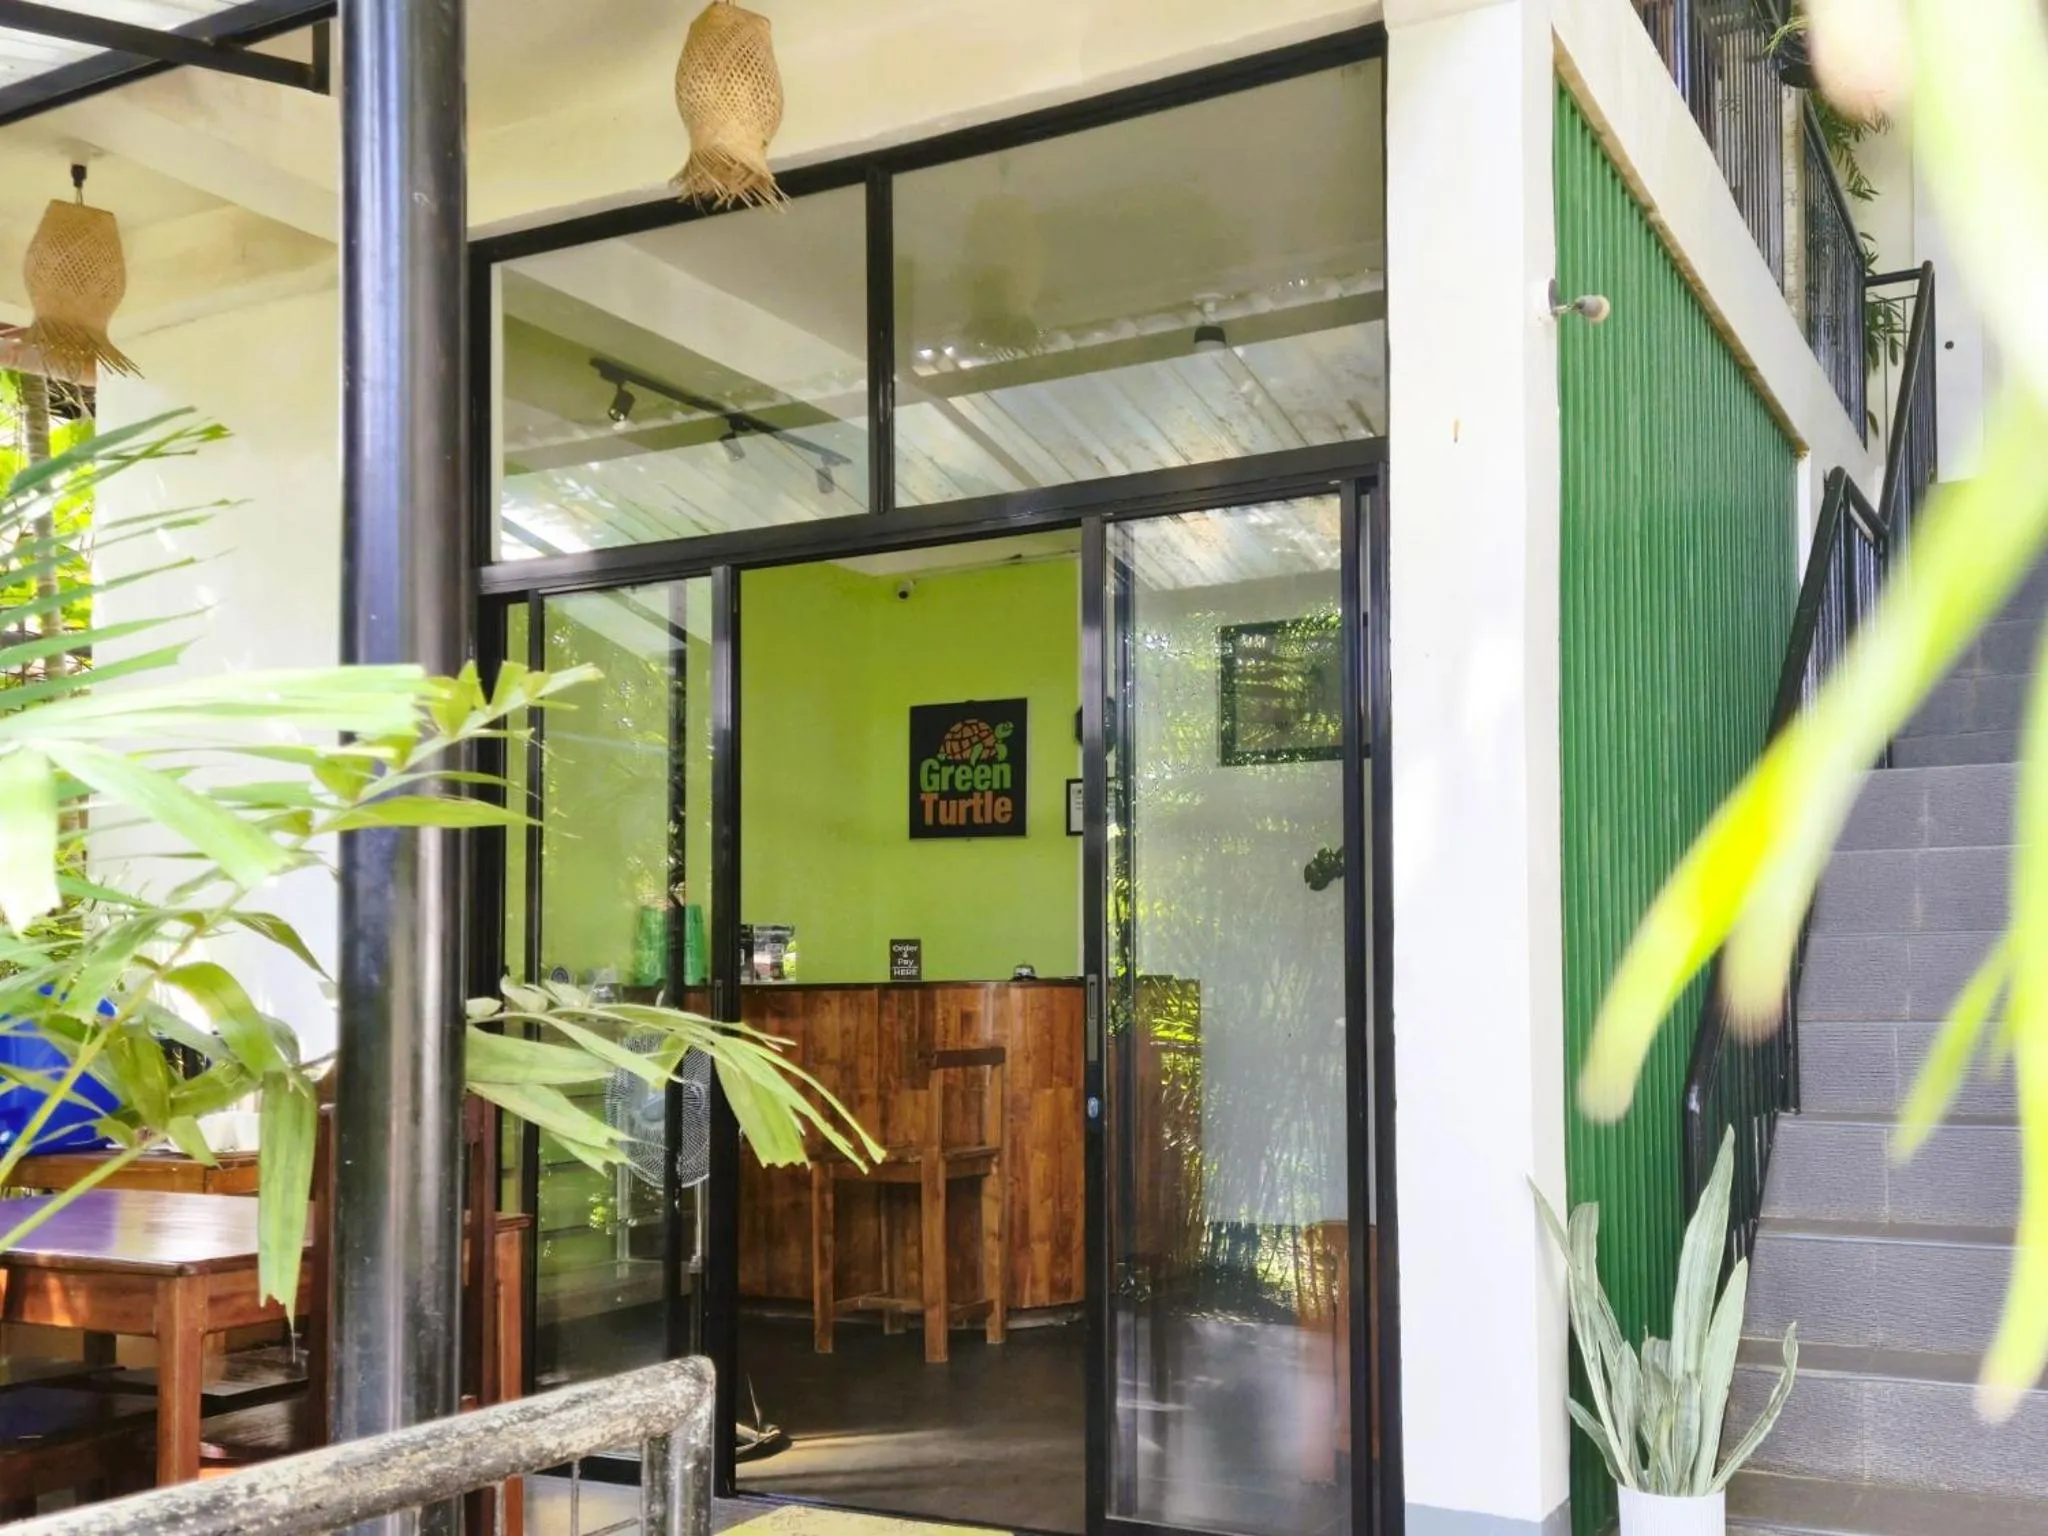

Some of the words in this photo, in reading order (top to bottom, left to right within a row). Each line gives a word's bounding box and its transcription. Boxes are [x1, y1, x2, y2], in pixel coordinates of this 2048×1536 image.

[920, 758, 1011, 792] Green
[920, 791, 1012, 826] Turtle
[893, 968, 918, 976] HERE
[897, 958, 914, 968] Pay
